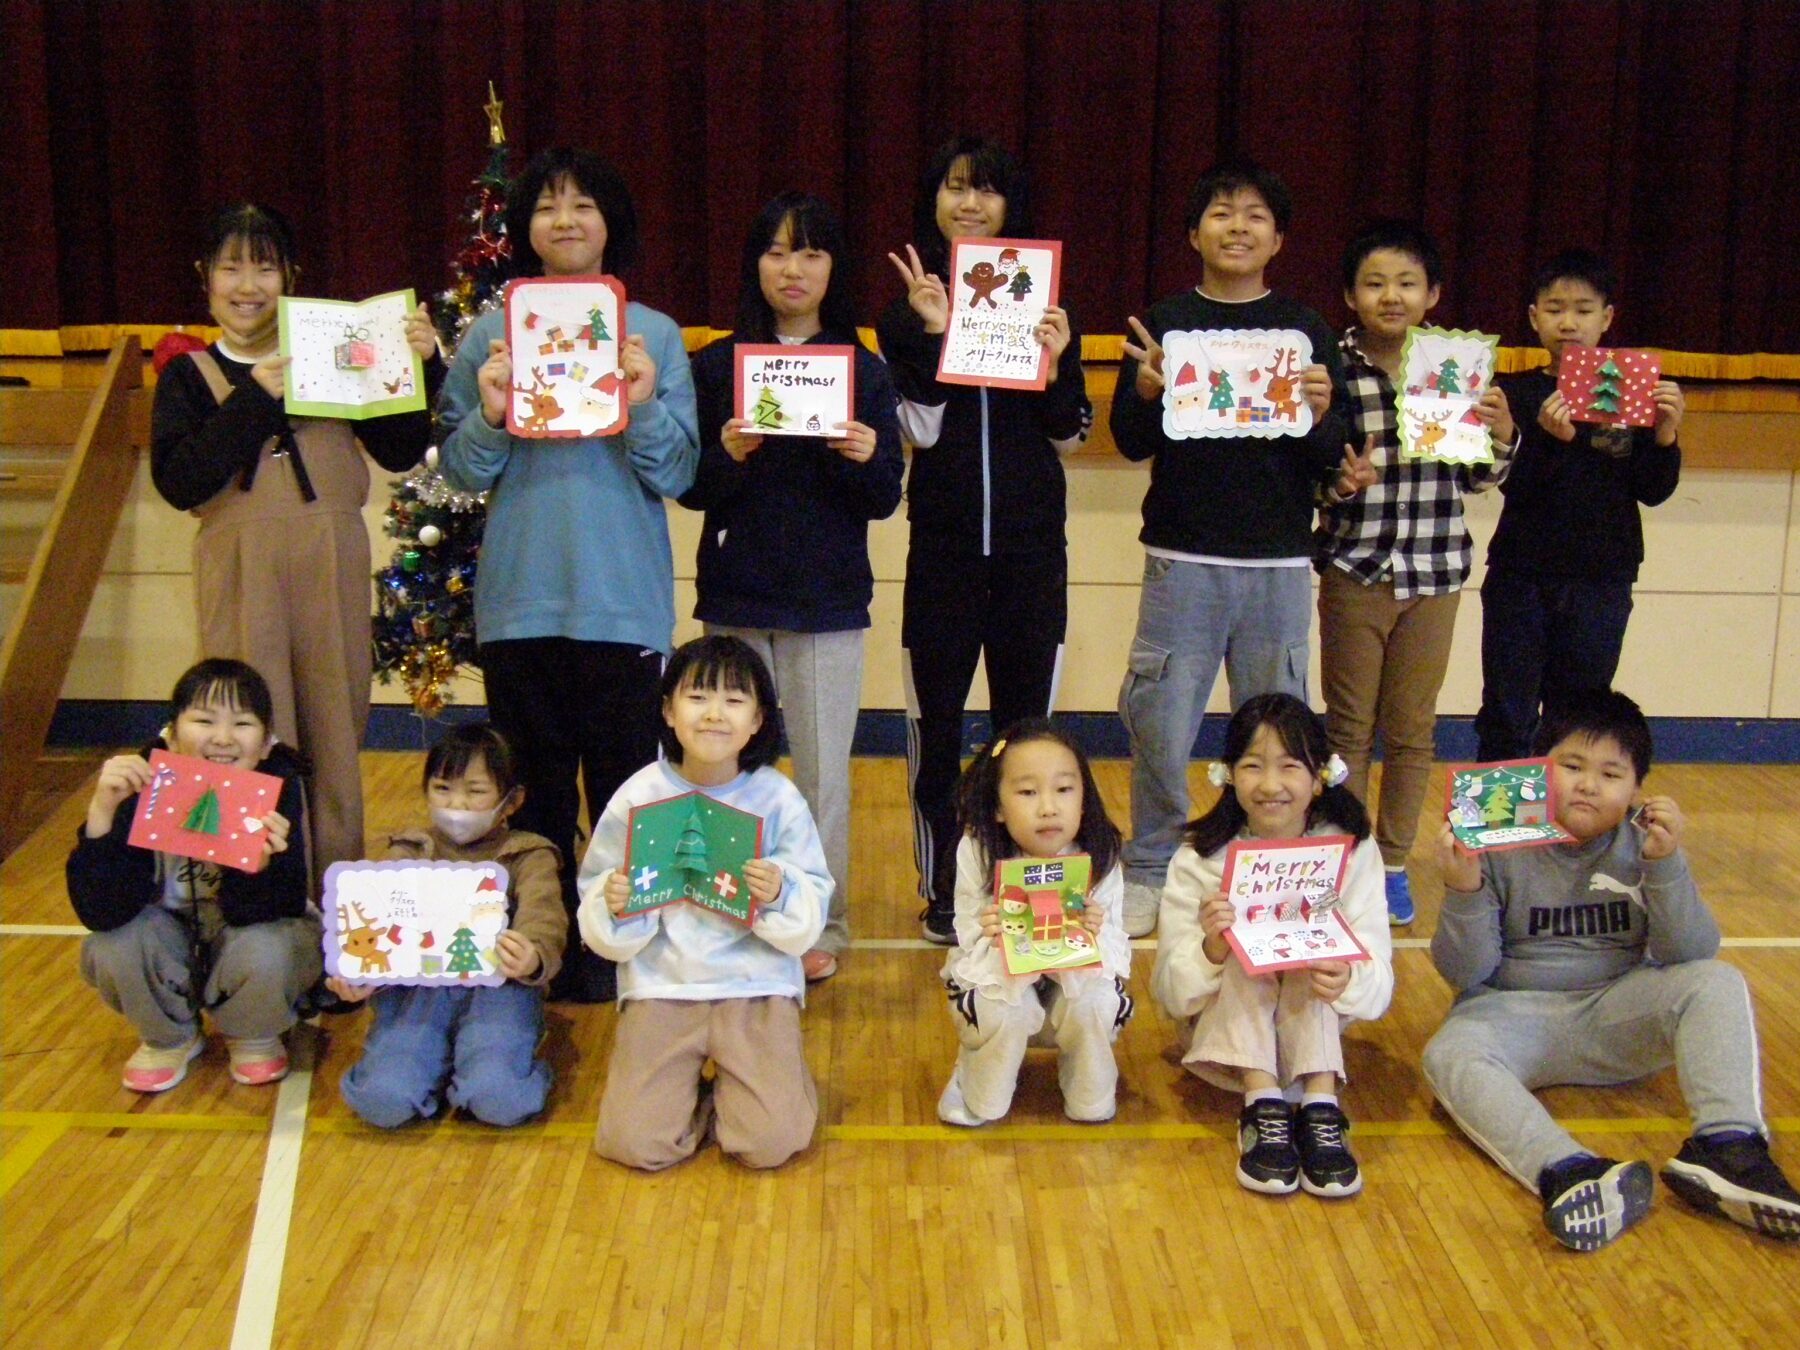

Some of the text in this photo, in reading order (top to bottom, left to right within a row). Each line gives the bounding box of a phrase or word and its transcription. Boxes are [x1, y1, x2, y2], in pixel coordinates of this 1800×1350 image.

[763, 359, 809, 371] Merry
[966, 349, 1033, 365] メリークリスマス
[1251, 859, 1326, 877] Merry
[628, 884, 748, 920] Merry Christmas
[1528, 900, 1631, 936] PUMA
